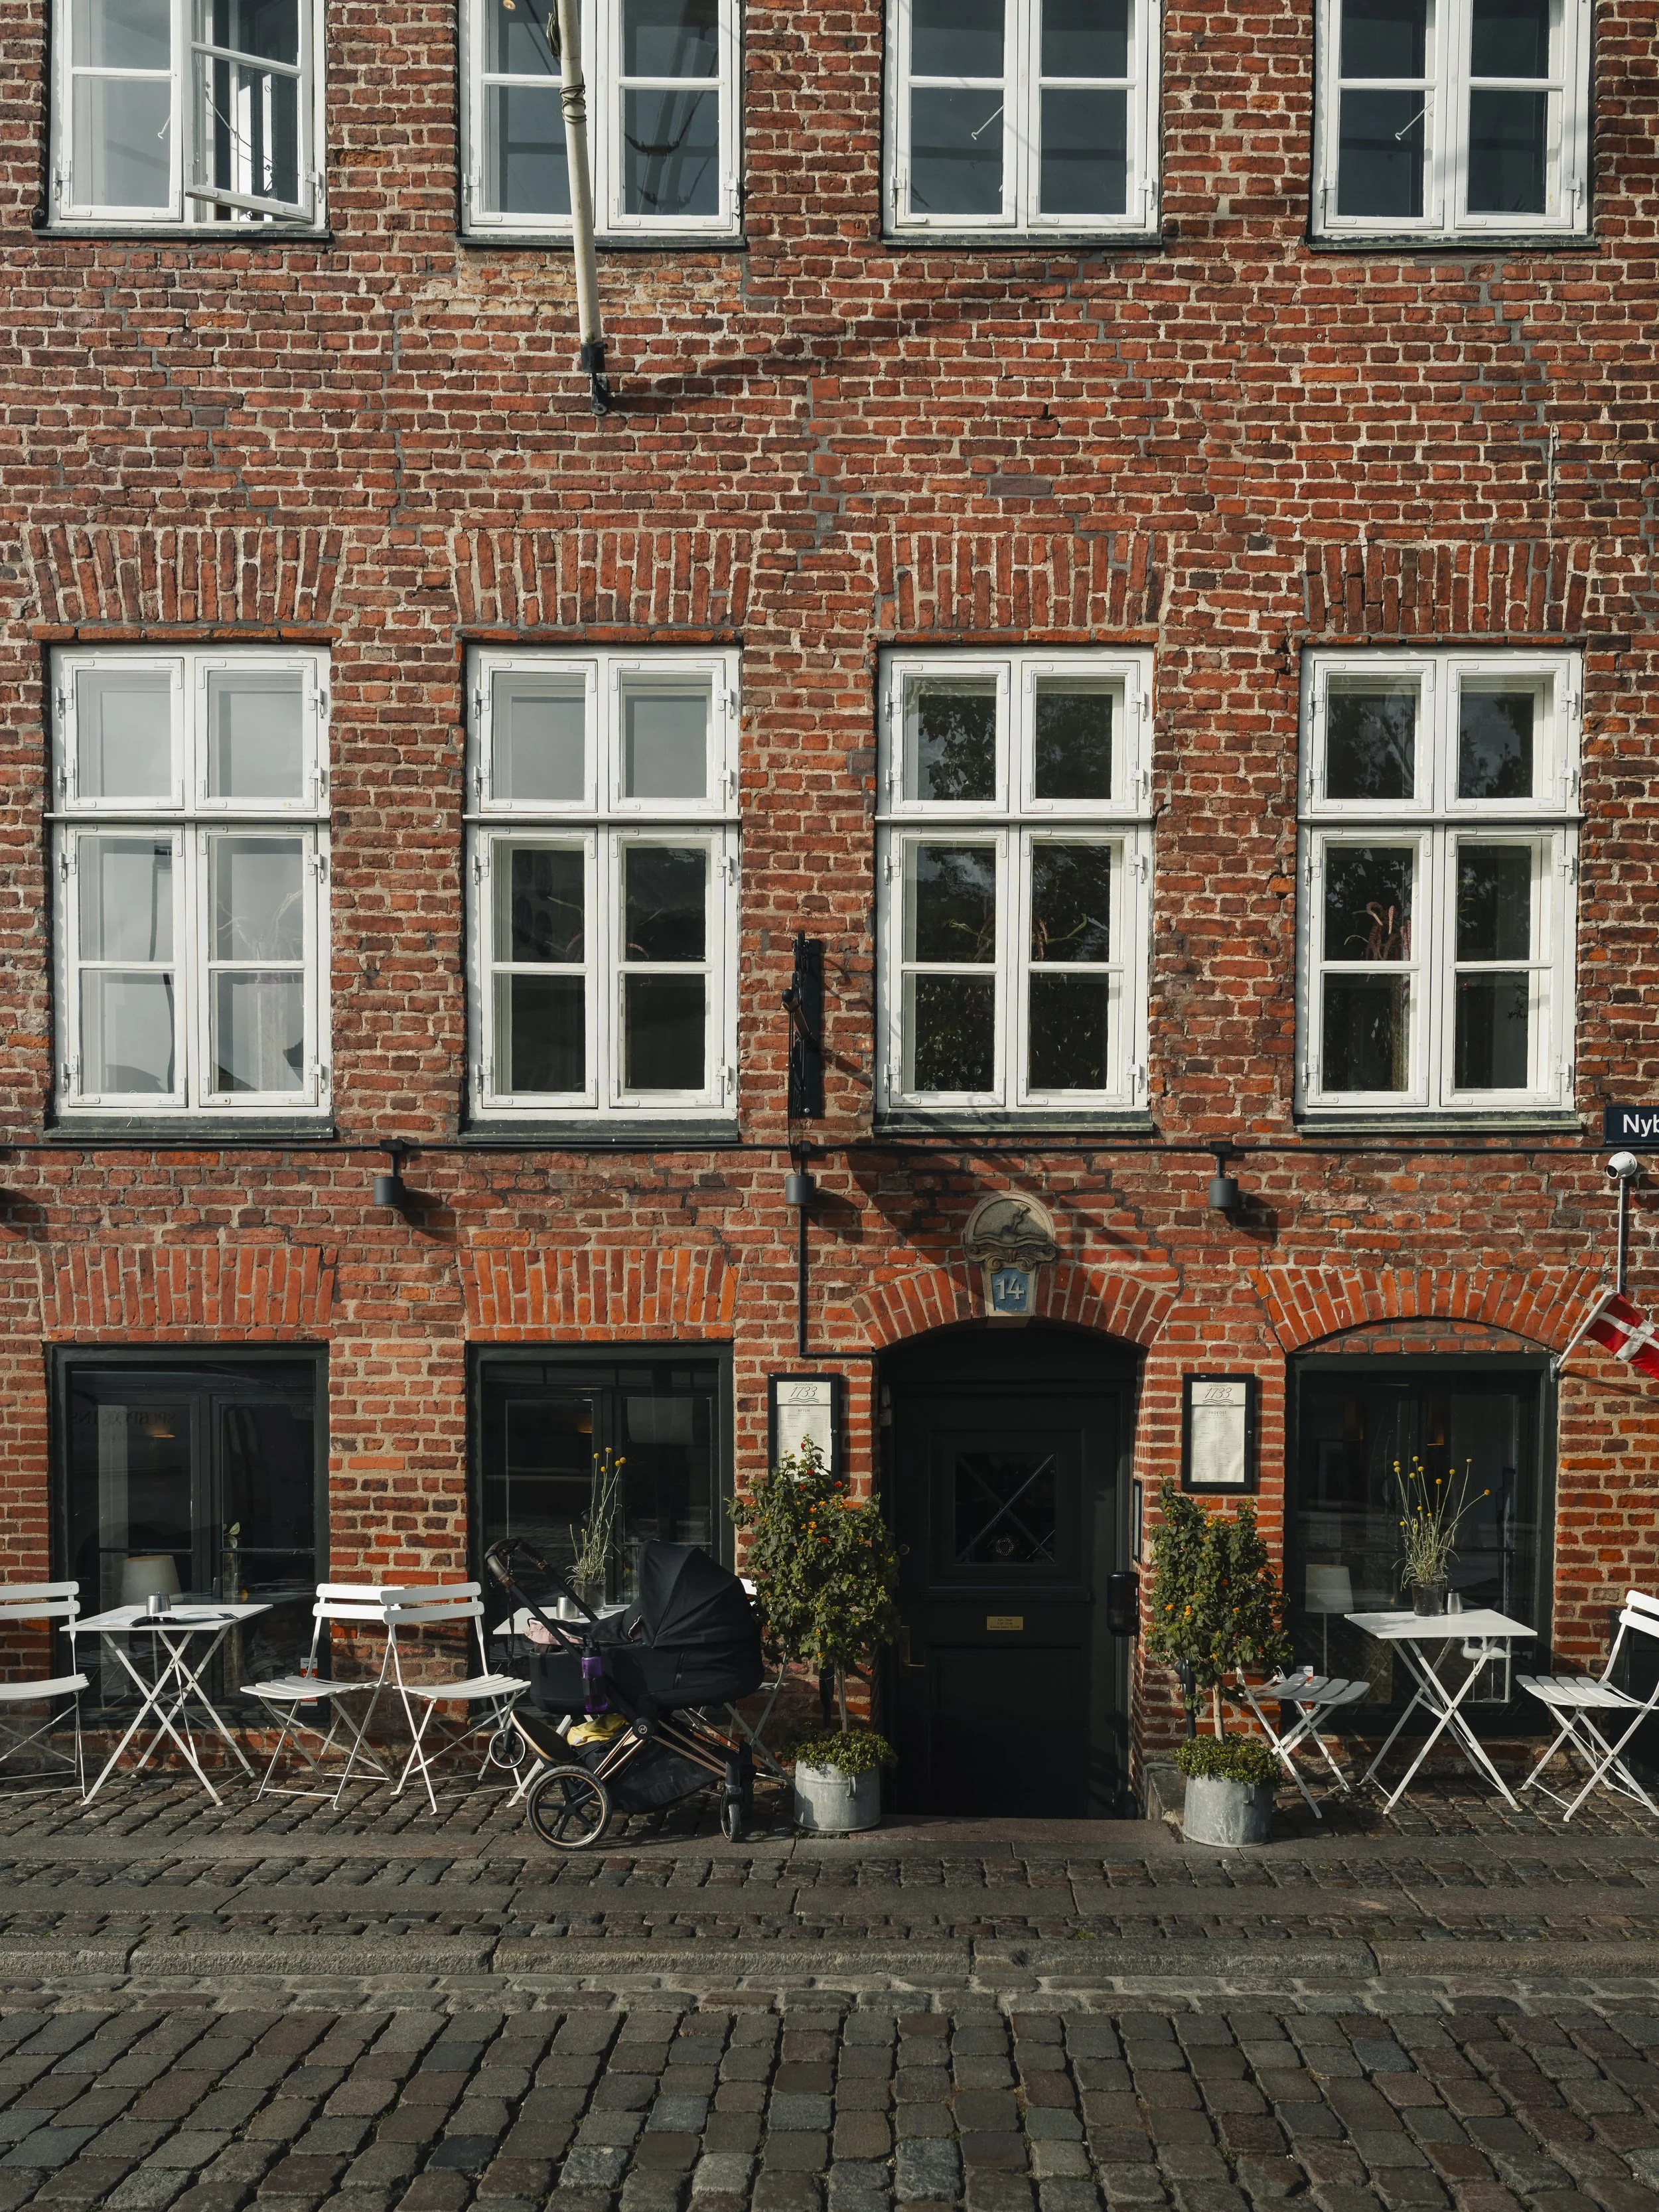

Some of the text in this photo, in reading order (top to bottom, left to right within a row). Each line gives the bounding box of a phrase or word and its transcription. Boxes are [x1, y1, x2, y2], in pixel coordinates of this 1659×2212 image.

[995, 1278, 1025, 1300] 14
[790, 1386, 818, 1397] 1733
[1204, 1387, 1232, 1398] 1733
